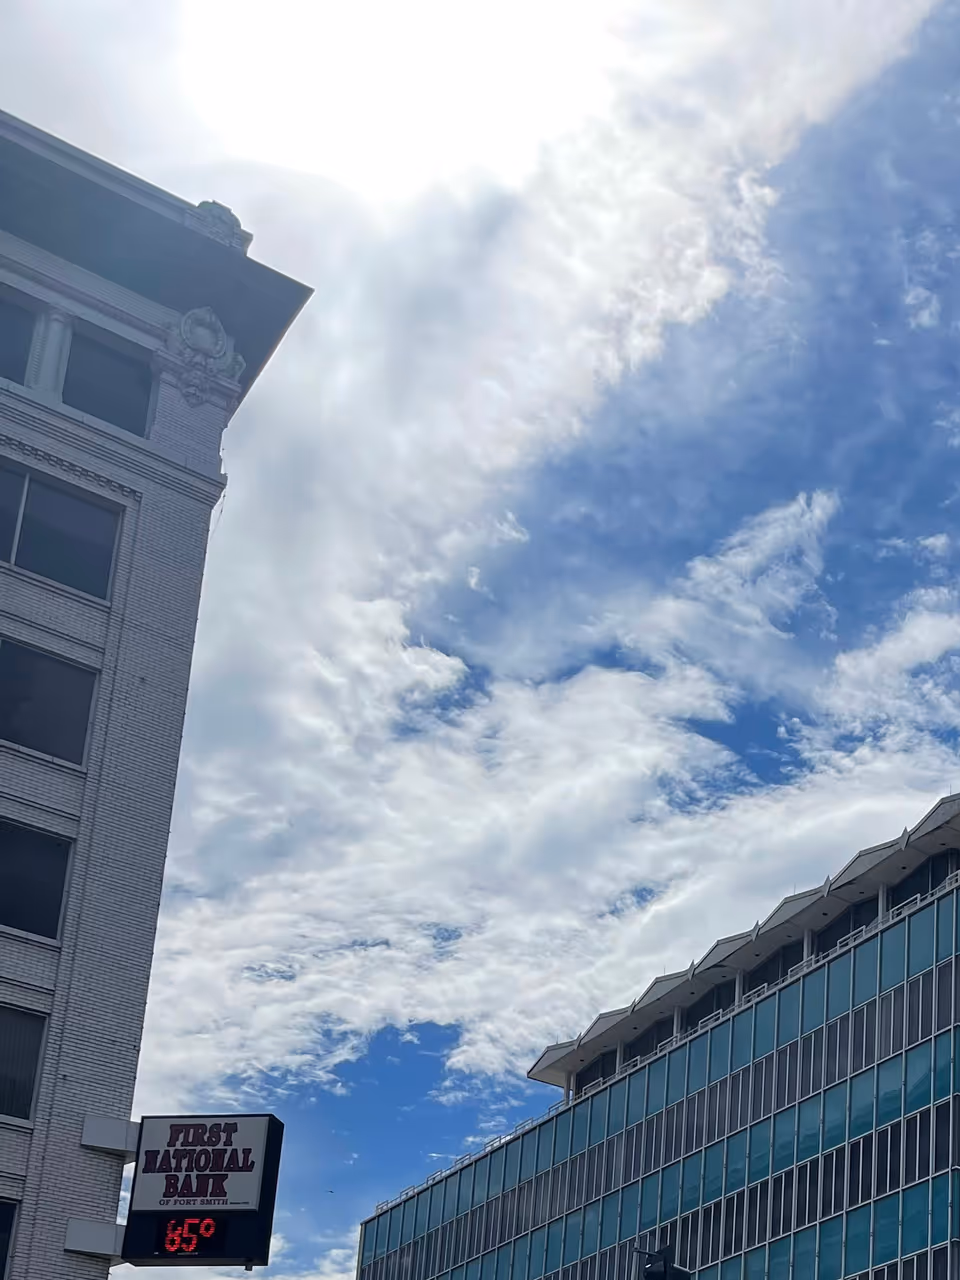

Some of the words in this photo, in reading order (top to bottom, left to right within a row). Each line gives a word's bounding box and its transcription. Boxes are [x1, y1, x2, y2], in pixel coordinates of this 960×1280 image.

[167, 1122, 238, 1147] FIRST
[142, 1148, 255, 1174] NATIONAL
[163, 1174, 228, 1198] BANK
[174, 1198, 198, 1206] FORT
[200, 1198, 228, 1206] SMITH
